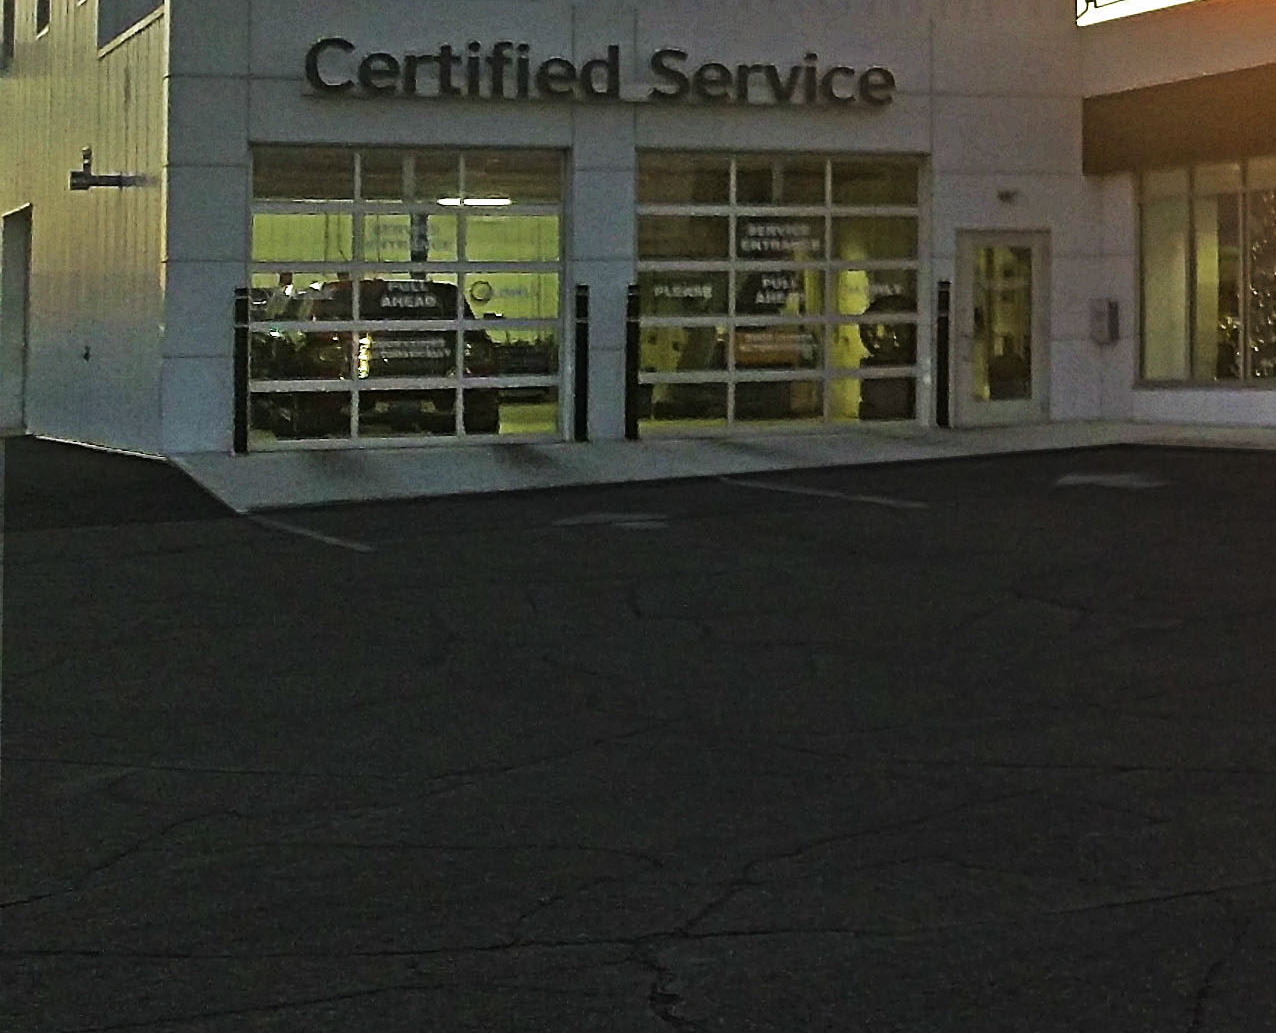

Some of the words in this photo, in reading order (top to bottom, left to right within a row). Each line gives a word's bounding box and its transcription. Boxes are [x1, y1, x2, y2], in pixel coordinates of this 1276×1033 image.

[304, 36, 620, 98] Certified
[647, 48, 896, 106] Service
[380, 294, 437, 307] AHEAD
